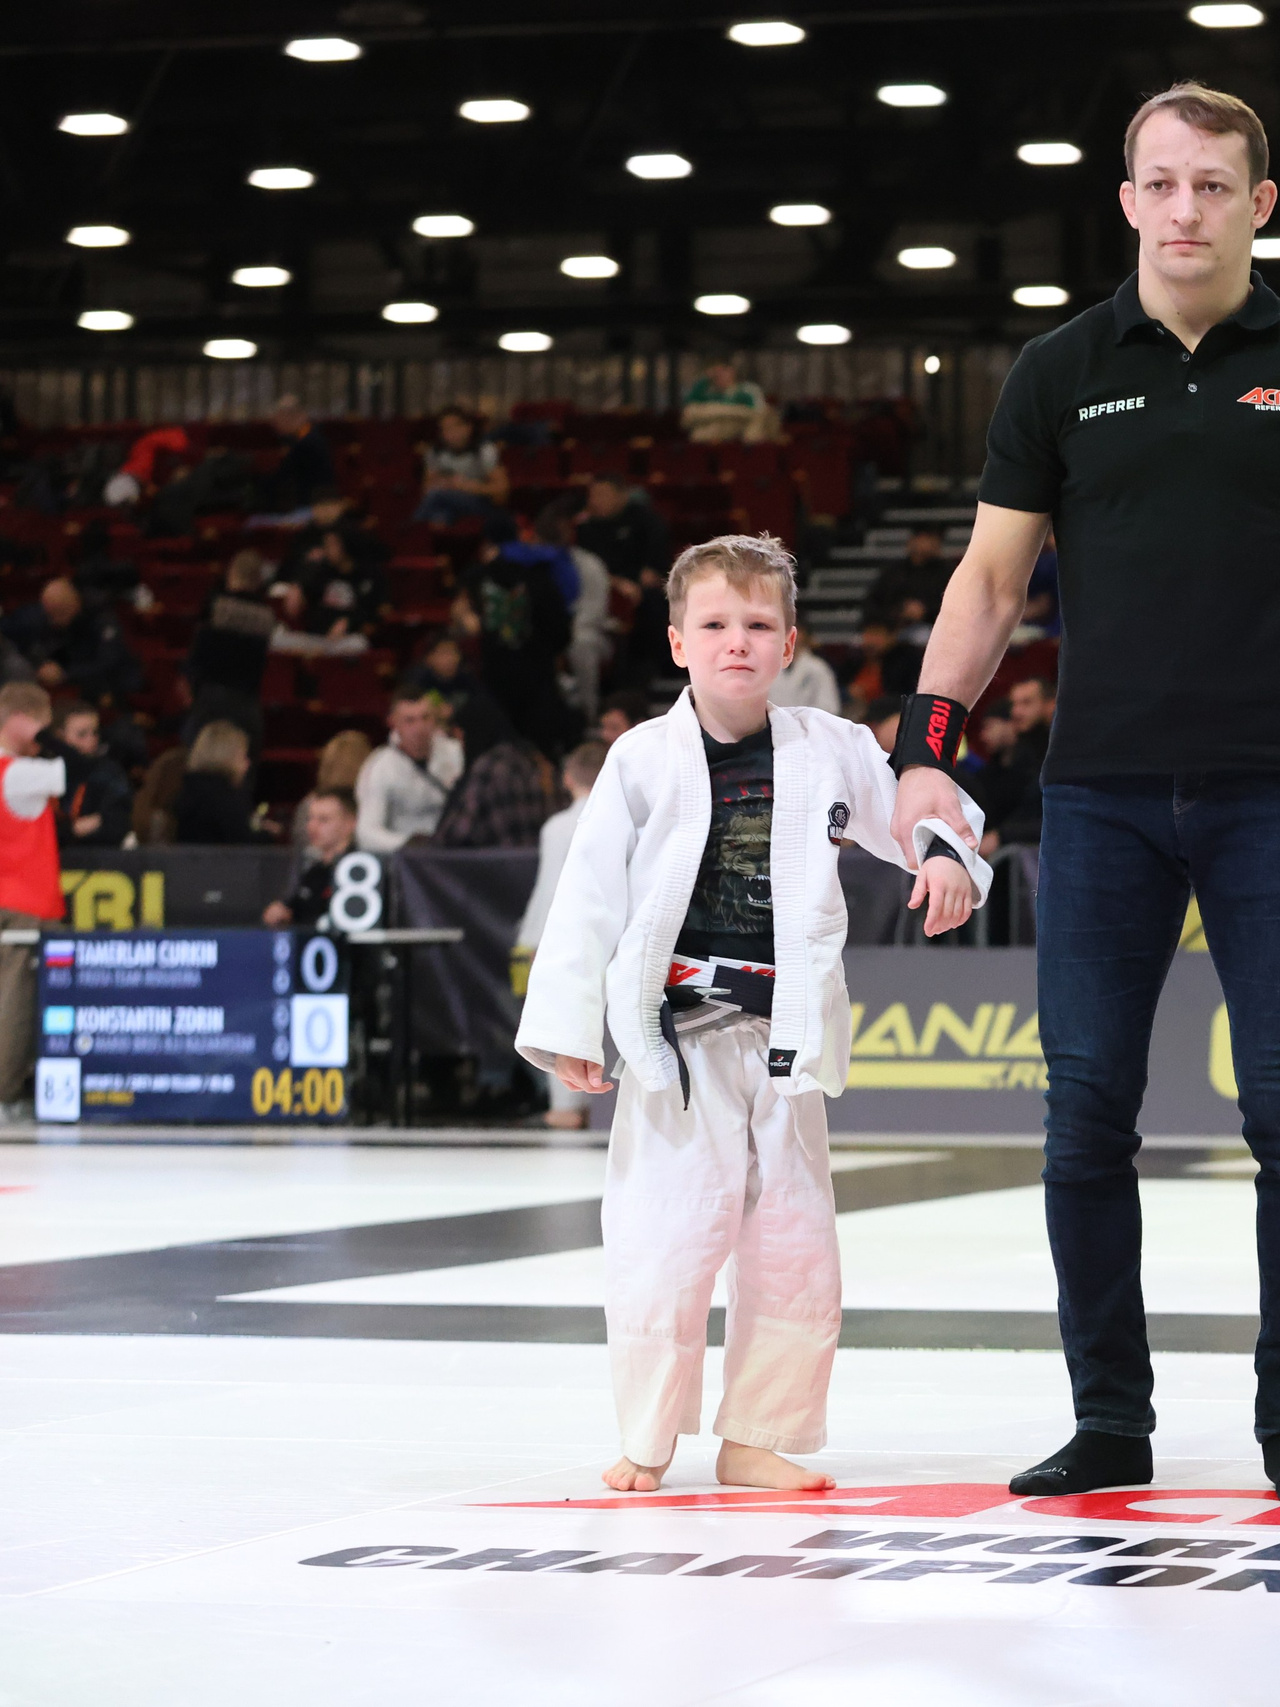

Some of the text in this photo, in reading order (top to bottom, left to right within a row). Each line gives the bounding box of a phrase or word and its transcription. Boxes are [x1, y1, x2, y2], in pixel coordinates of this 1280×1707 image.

[1079, 396, 1146, 421] REFEREE
[329, 851, 383, 932] 8
[301, 935, 339, 993] 0
[305, 1006, 335, 1055] 0
[252, 1066, 344, 1116] 04:00
